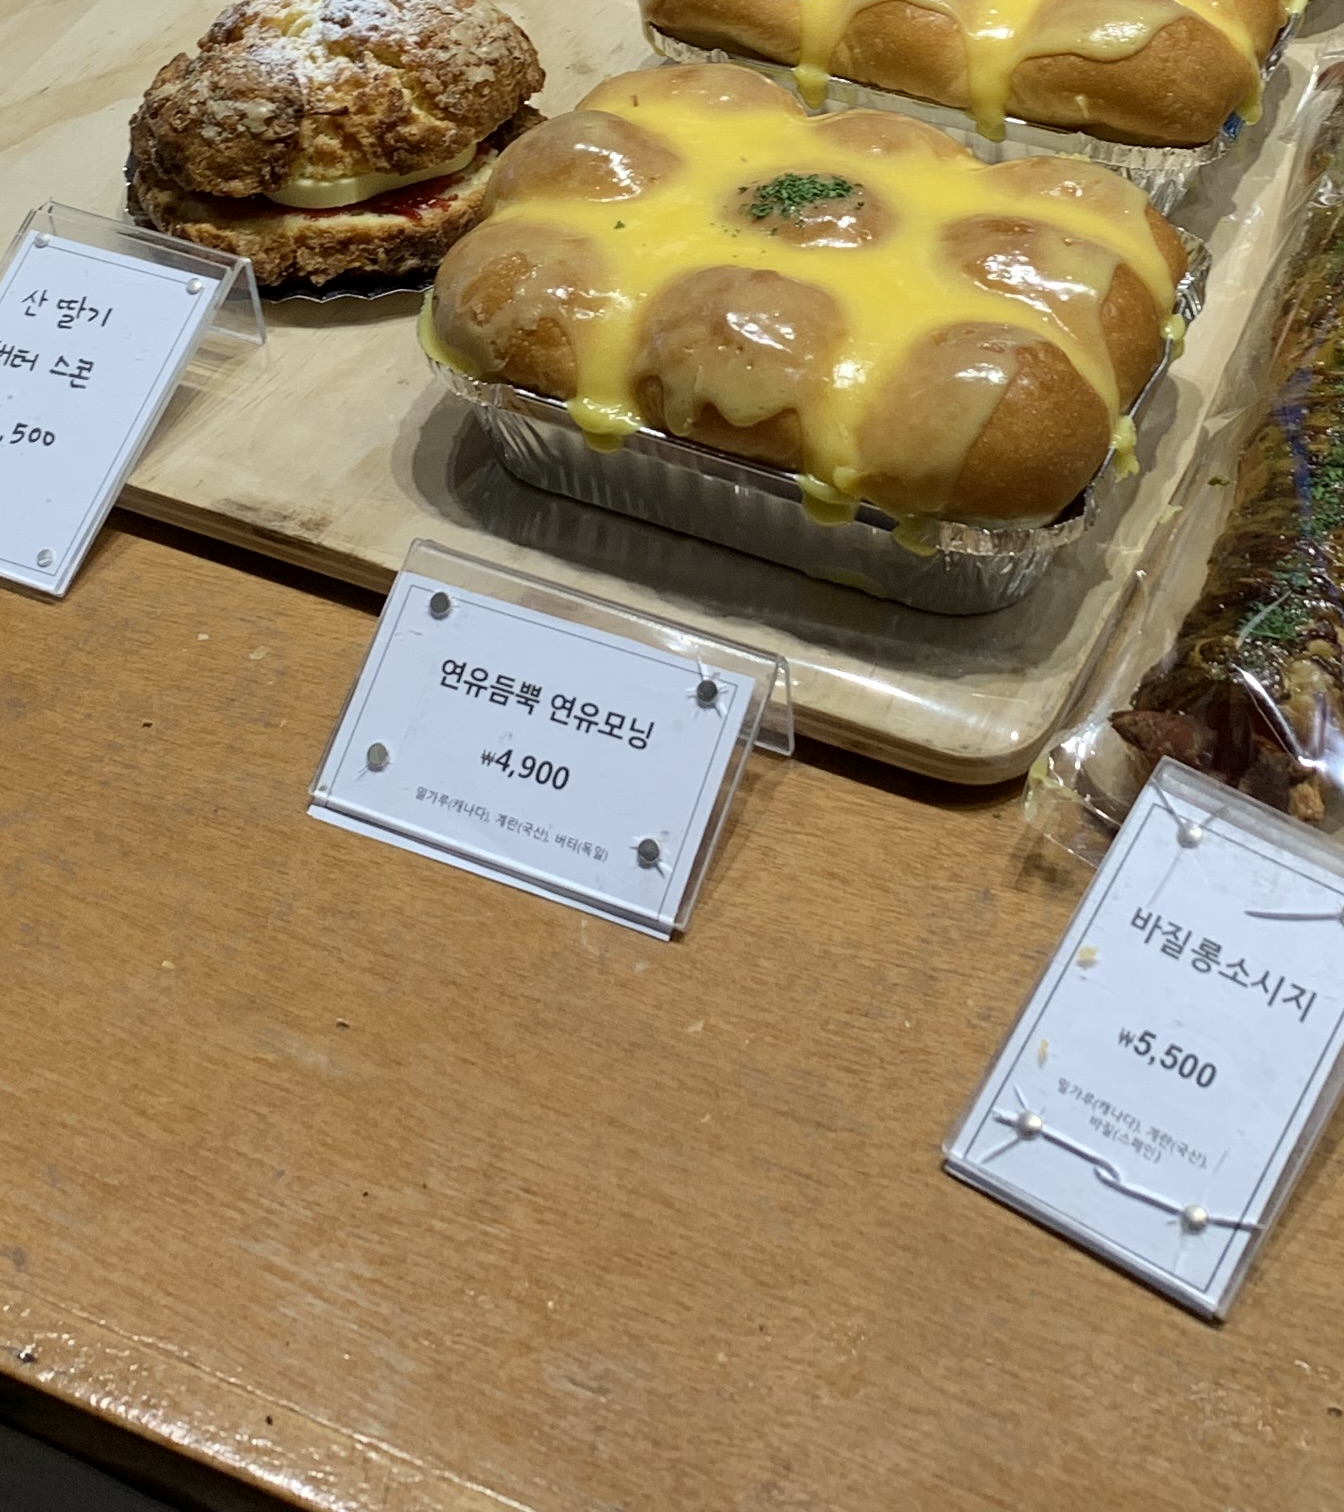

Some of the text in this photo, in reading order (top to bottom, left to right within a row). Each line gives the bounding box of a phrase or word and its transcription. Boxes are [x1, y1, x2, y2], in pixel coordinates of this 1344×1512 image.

[49, 357, 95, 389] 스콘
[440, 659, 655, 750] 연유듬뿍 연유모닝
[480, 748, 570, 791] ₩4,900
[415, 786, 490, 823] 밀가루(캐나다),
[555, 833, 608, 862] 버터(독일)
[1130, 905, 1319, 1023] 바질롱소시지
[1117, 1027, 1217, 1089] ₩5,500
[1089, 1115, 1162, 1163] 바질(스페인)
